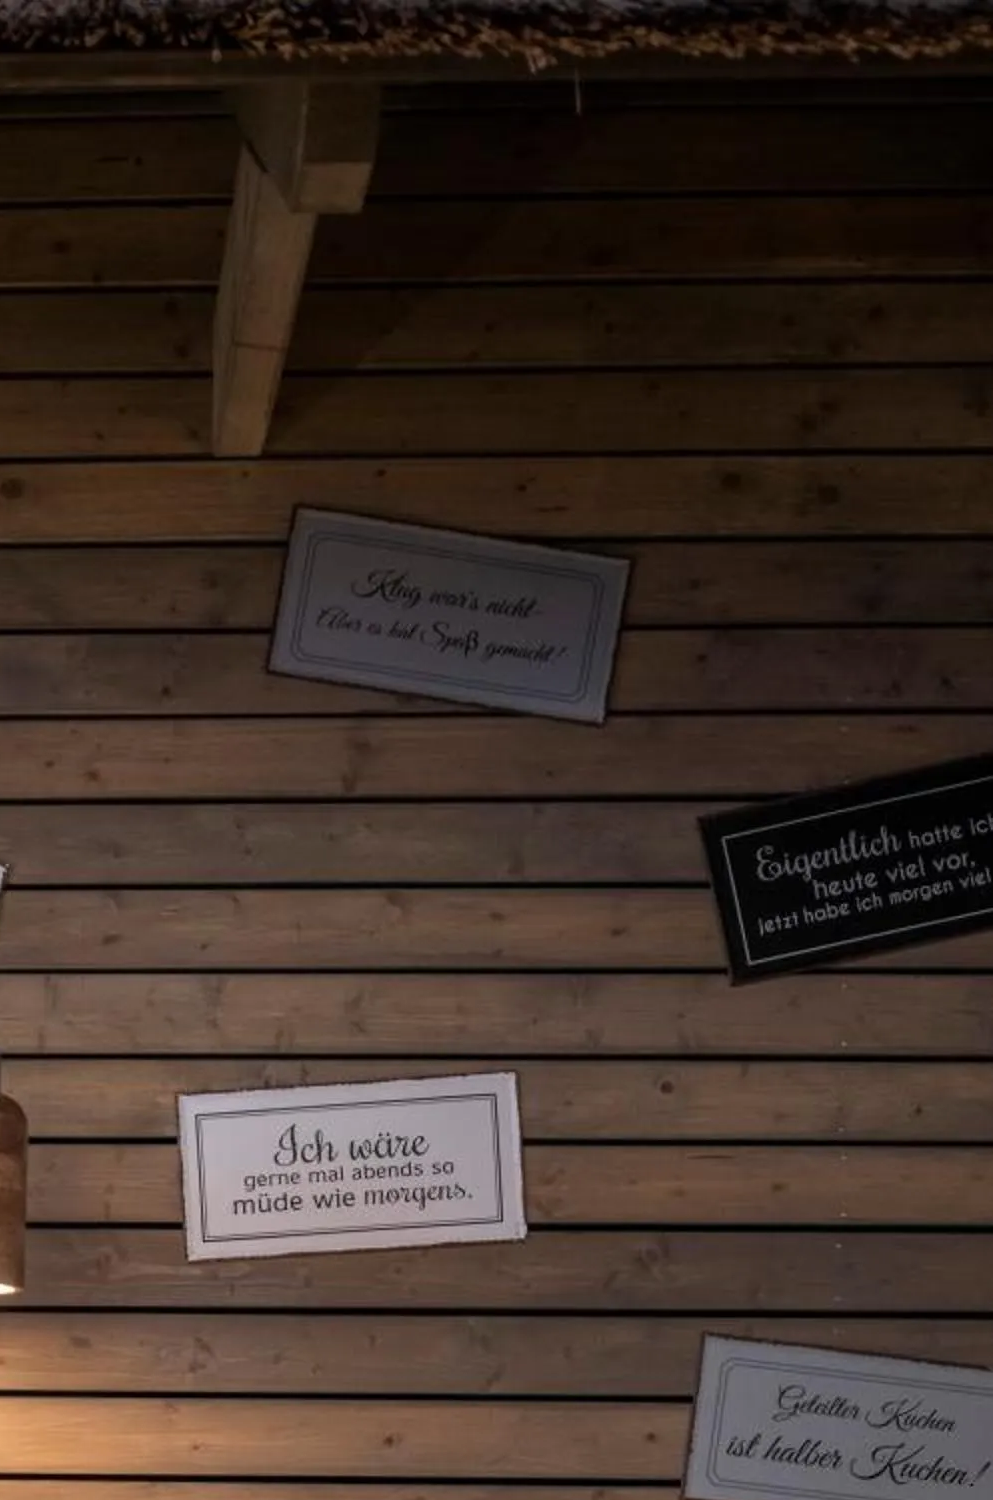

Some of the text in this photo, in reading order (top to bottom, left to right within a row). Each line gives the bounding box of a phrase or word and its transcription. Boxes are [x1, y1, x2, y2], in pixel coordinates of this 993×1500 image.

[350, 569, 422, 610] Klug
[755, 825, 902, 882] Eigentlich
[908, 824, 964, 848] hatte
[803, 900, 851, 924] habe
[889, 879, 954, 905] morgen
[958, 866, 992, 889] viel
[813, 871, 879, 901] heute
[886, 855, 926, 883] viel
[273, 1123, 430, 1167] Ich wäre
[233, 1183, 473, 1215] müde wie morgens.
[243, 1160, 455, 1192] gerne mal abends so
[771, 1384, 956, 1432] Geteilter Kuchen
[725, 1433, 992, 1487] ist halber Kuchen!
